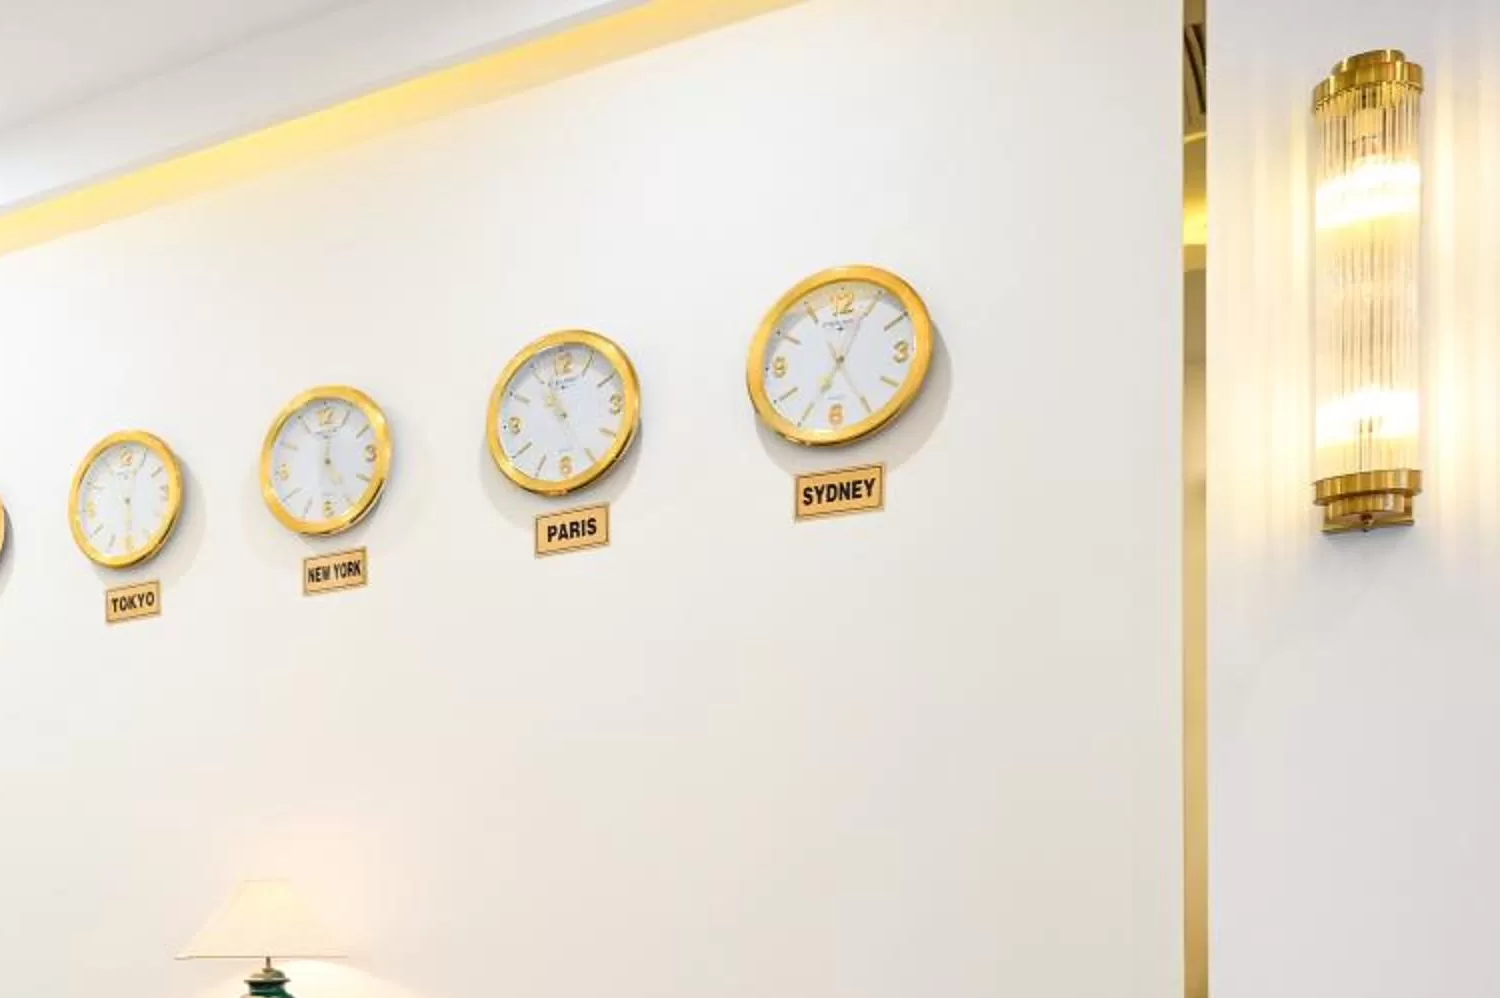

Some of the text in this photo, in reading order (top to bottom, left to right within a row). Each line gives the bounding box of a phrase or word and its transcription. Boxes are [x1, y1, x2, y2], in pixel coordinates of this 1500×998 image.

[893, 340, 909, 364] 3
[609, 393, 621, 415] 3
[828, 403, 844, 426] 6
[364, 443, 378, 462] 3
[802, 477, 876, 506] SYDNEY
[547, 517, 597, 542] PARIS
[307, 560, 361, 583] NEW YORK
[111, 591, 155, 613] TOKYO
